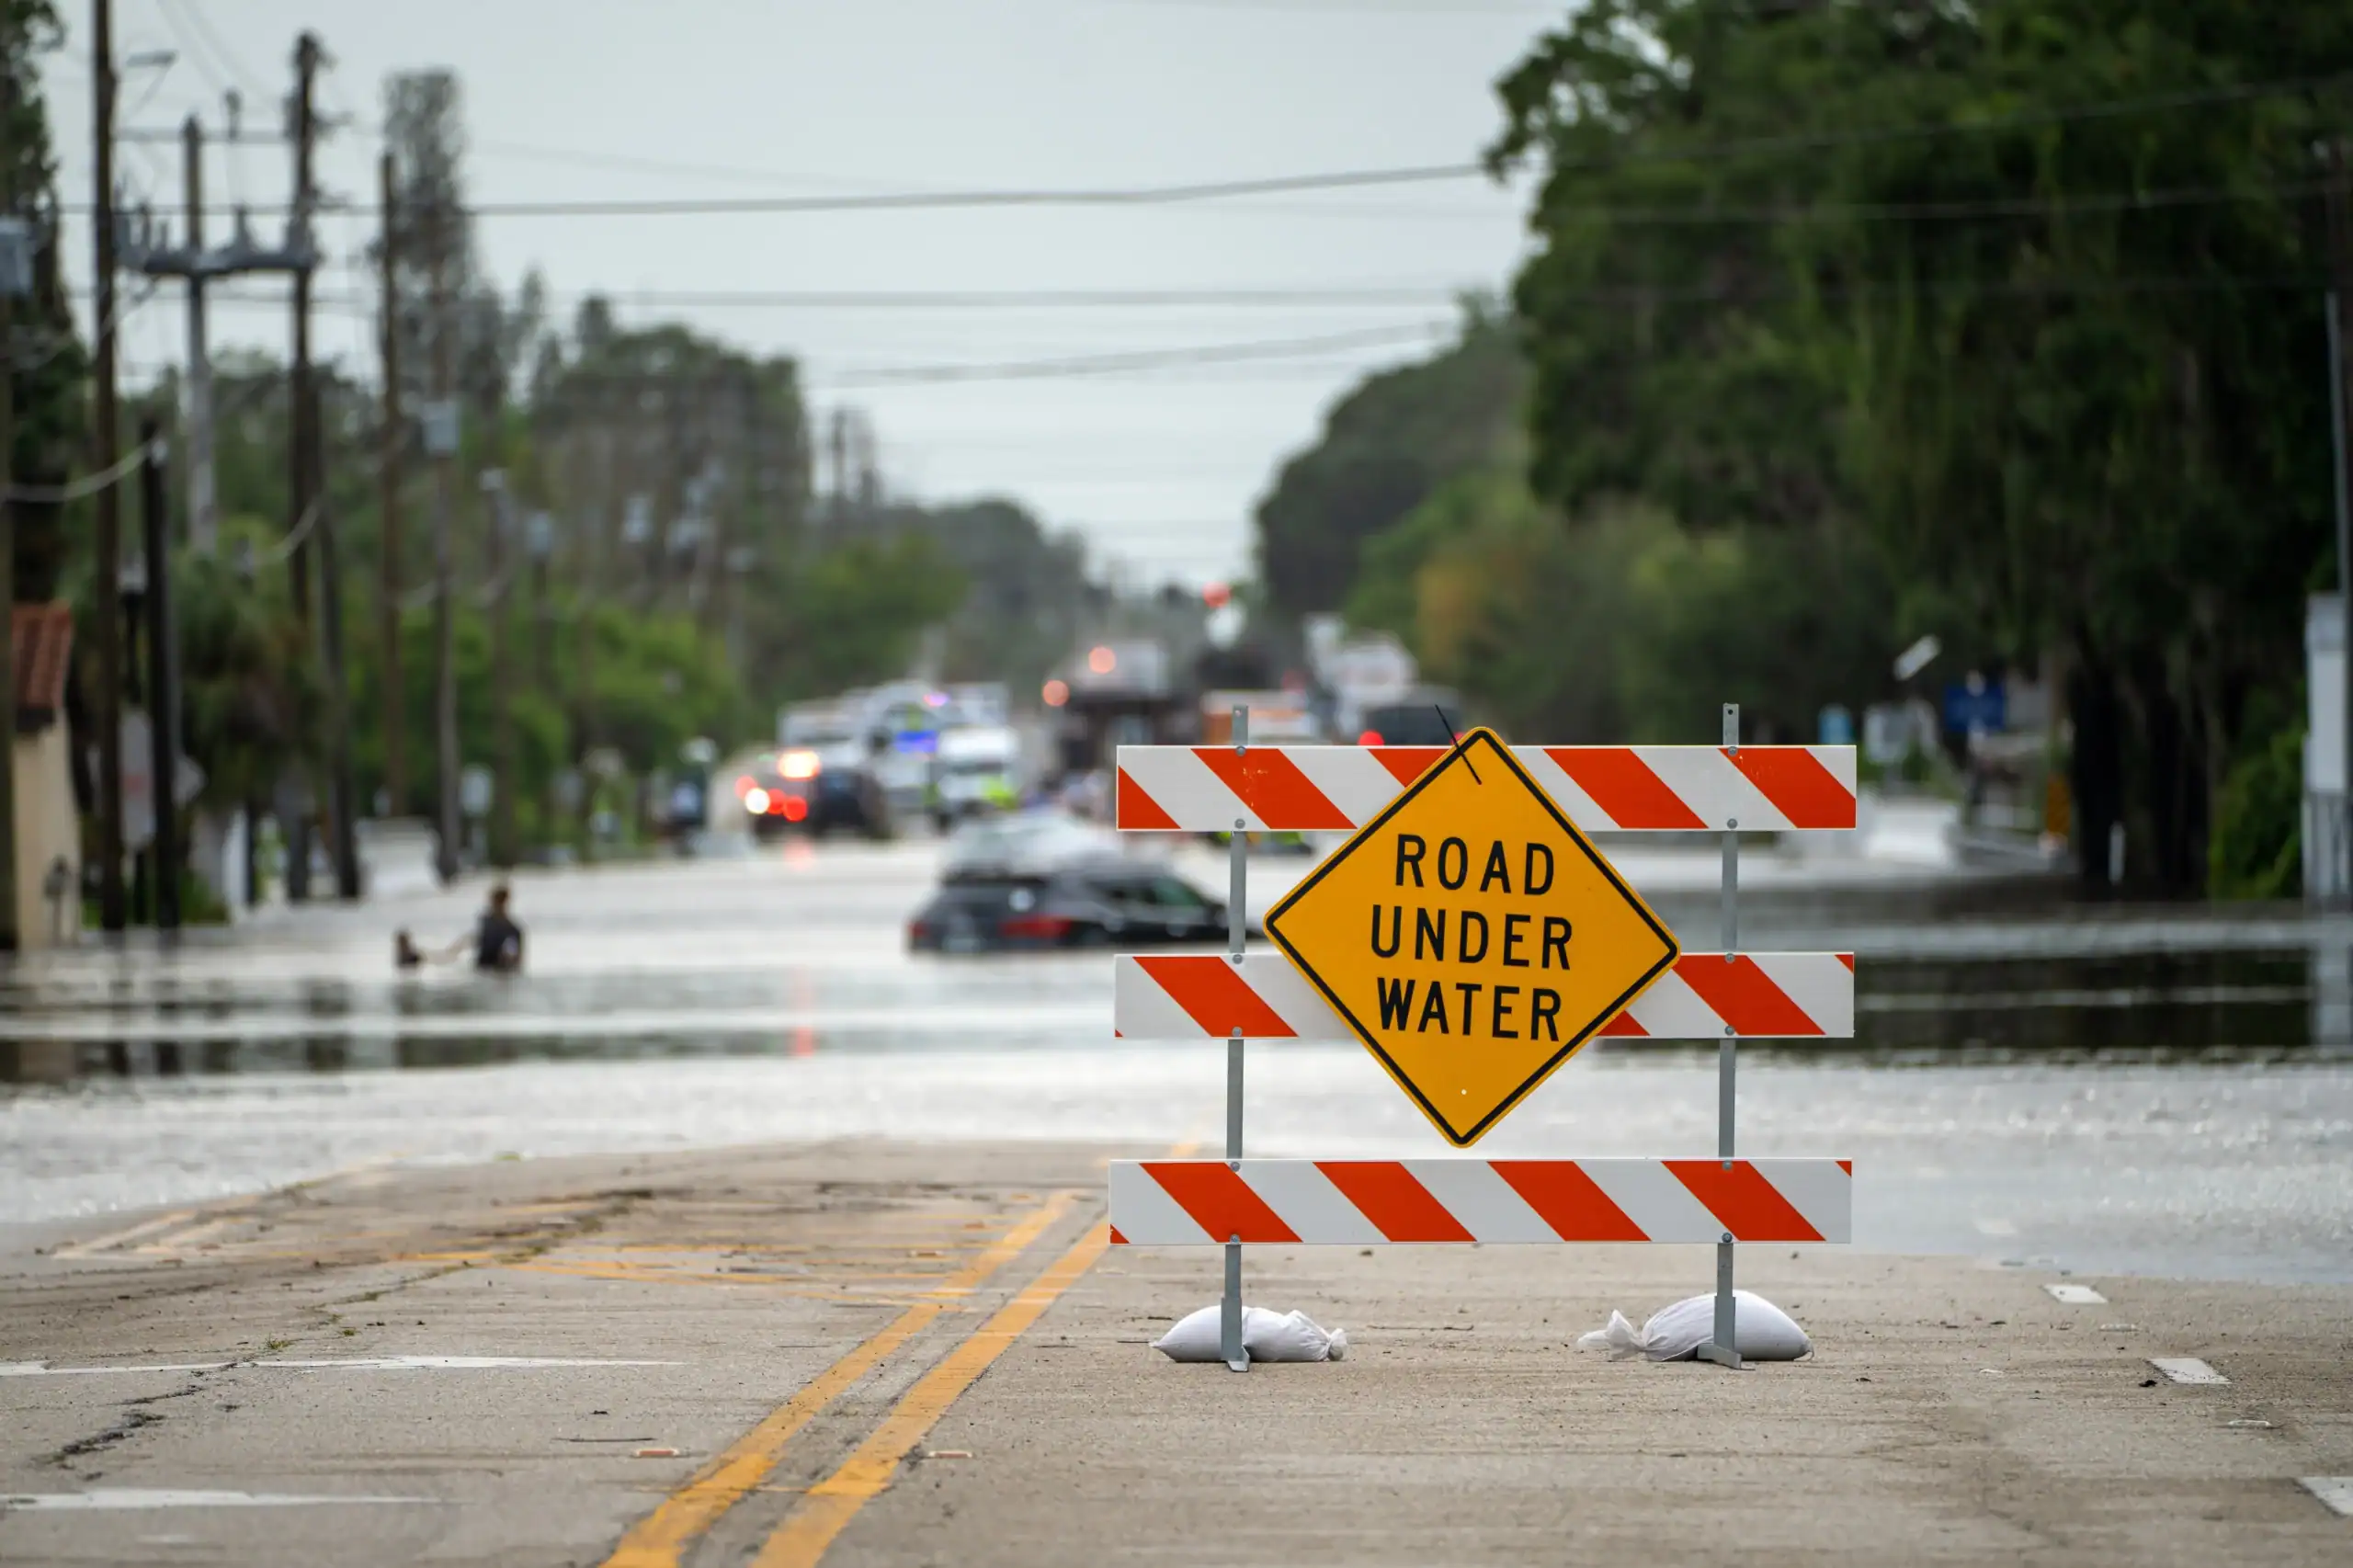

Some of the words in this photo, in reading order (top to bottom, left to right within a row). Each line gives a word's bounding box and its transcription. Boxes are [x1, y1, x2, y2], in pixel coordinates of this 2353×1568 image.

[1395, 834, 1554, 896] ROAD
[1370, 904, 1573, 971] UNDER
[1377, 977, 1562, 1041] WATER
